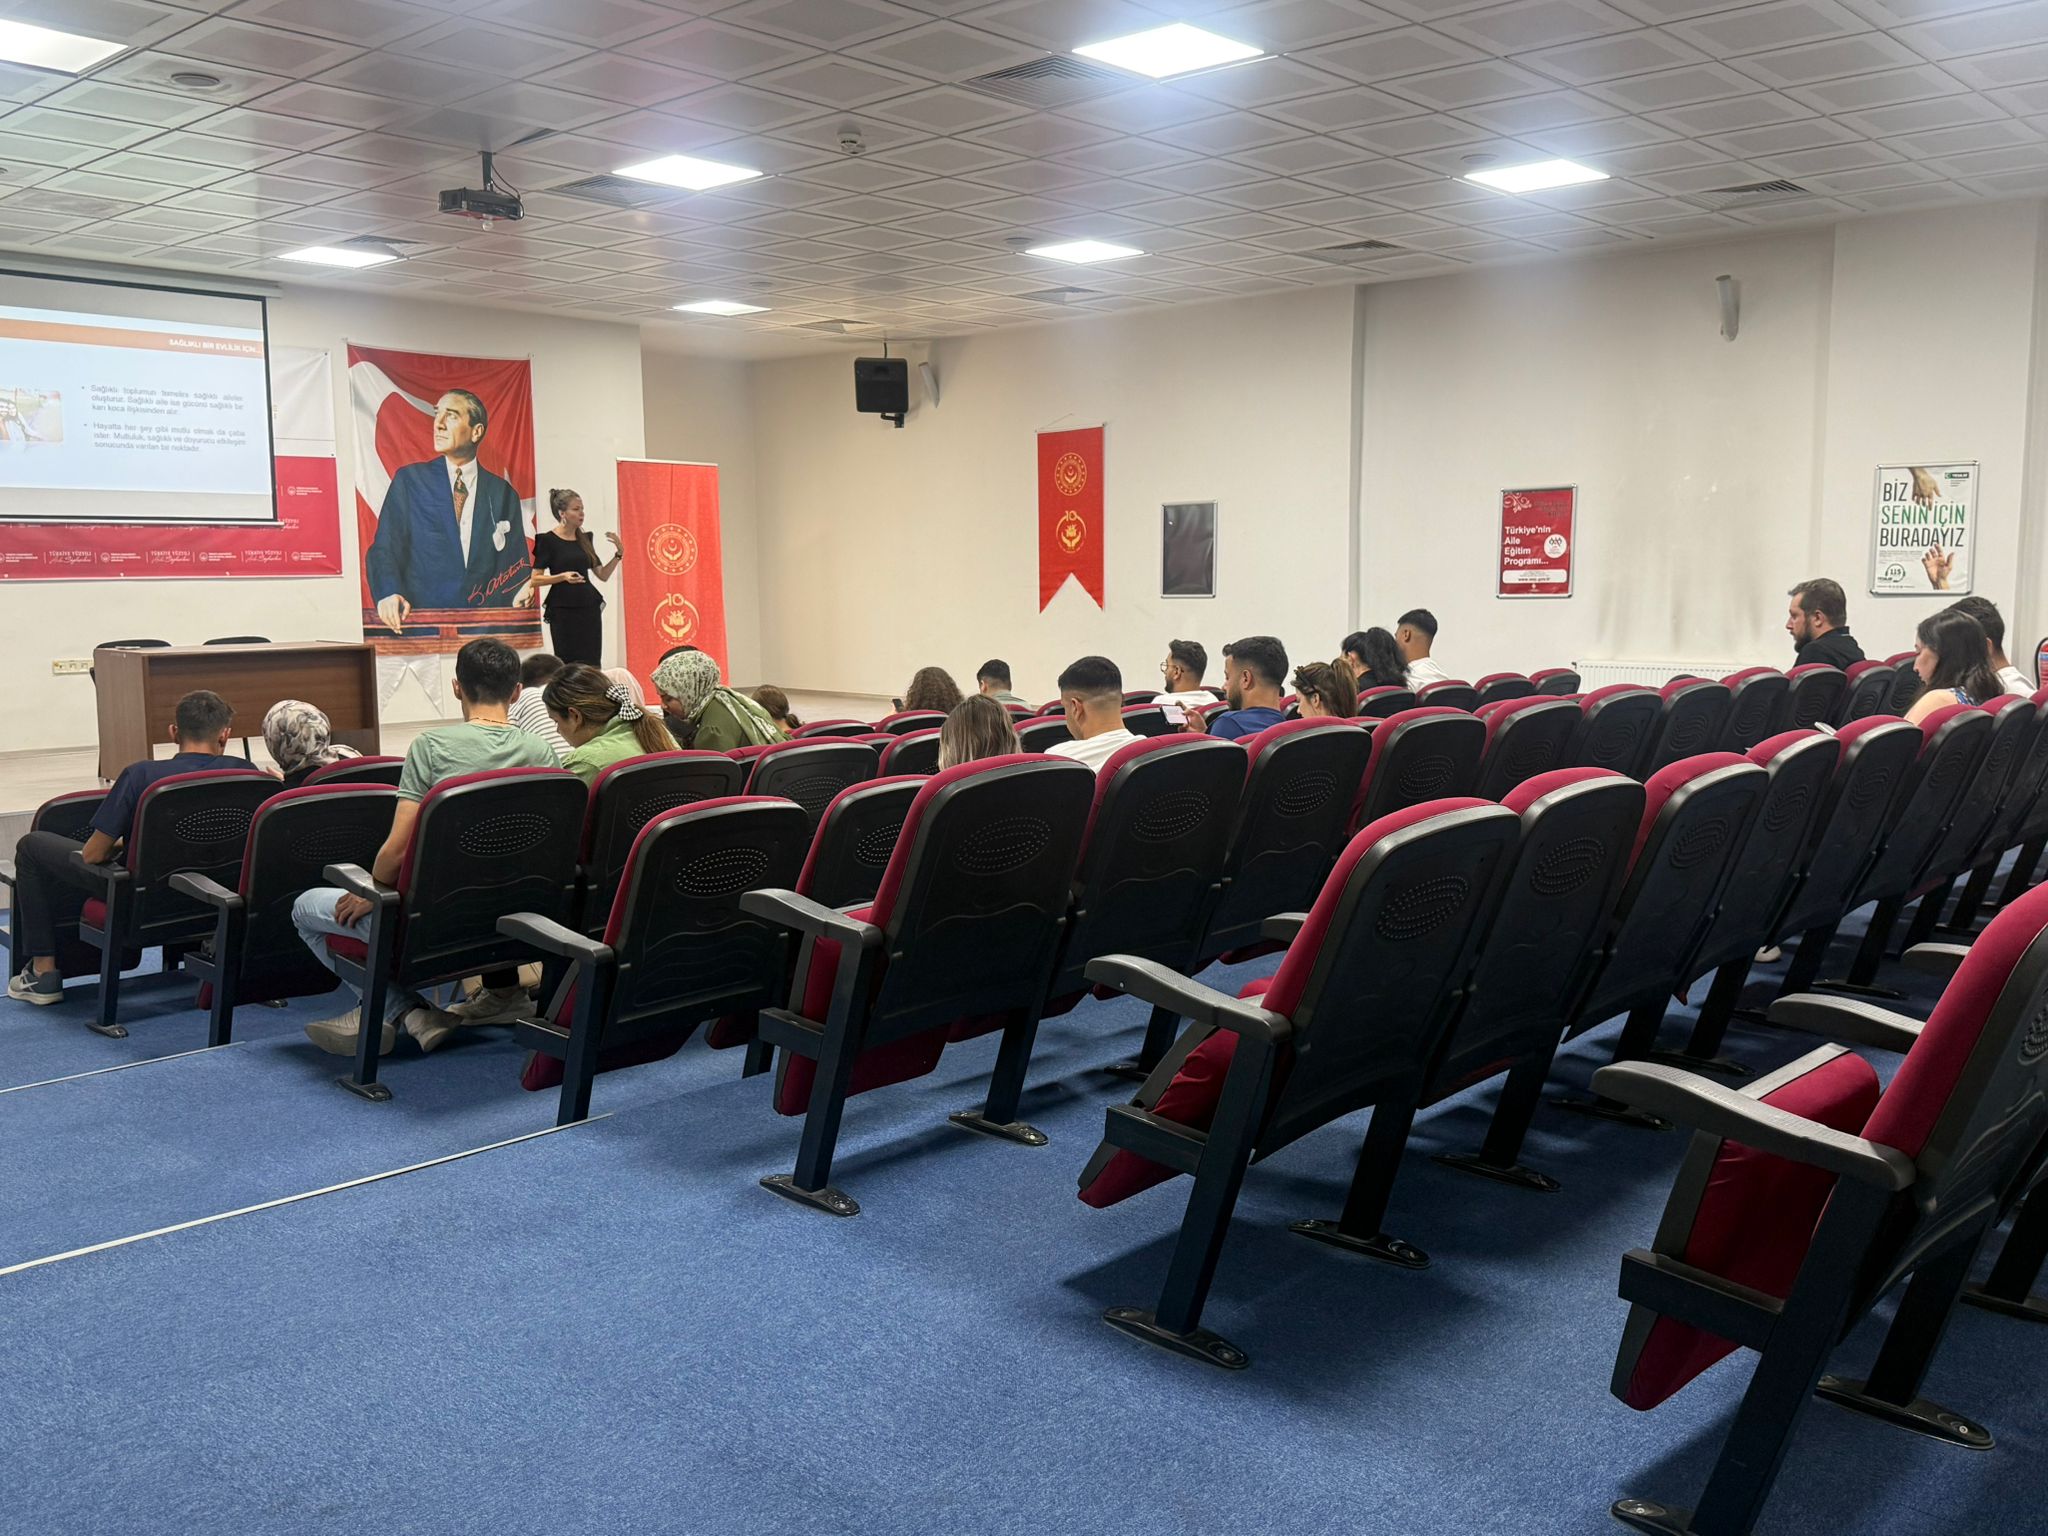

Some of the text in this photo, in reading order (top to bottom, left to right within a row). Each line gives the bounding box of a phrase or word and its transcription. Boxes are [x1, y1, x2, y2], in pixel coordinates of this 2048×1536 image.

[1883, 478, 1908, 502] BİZ
[1934, 500, 1965, 526] İÇİN
[1504, 525, 1551, 536] Türkiye'nin
[1880, 528, 1965, 547] BURADAYIZ
[1504, 546, 1531, 556] Eğitim
[666, 592, 685, 606] 10
